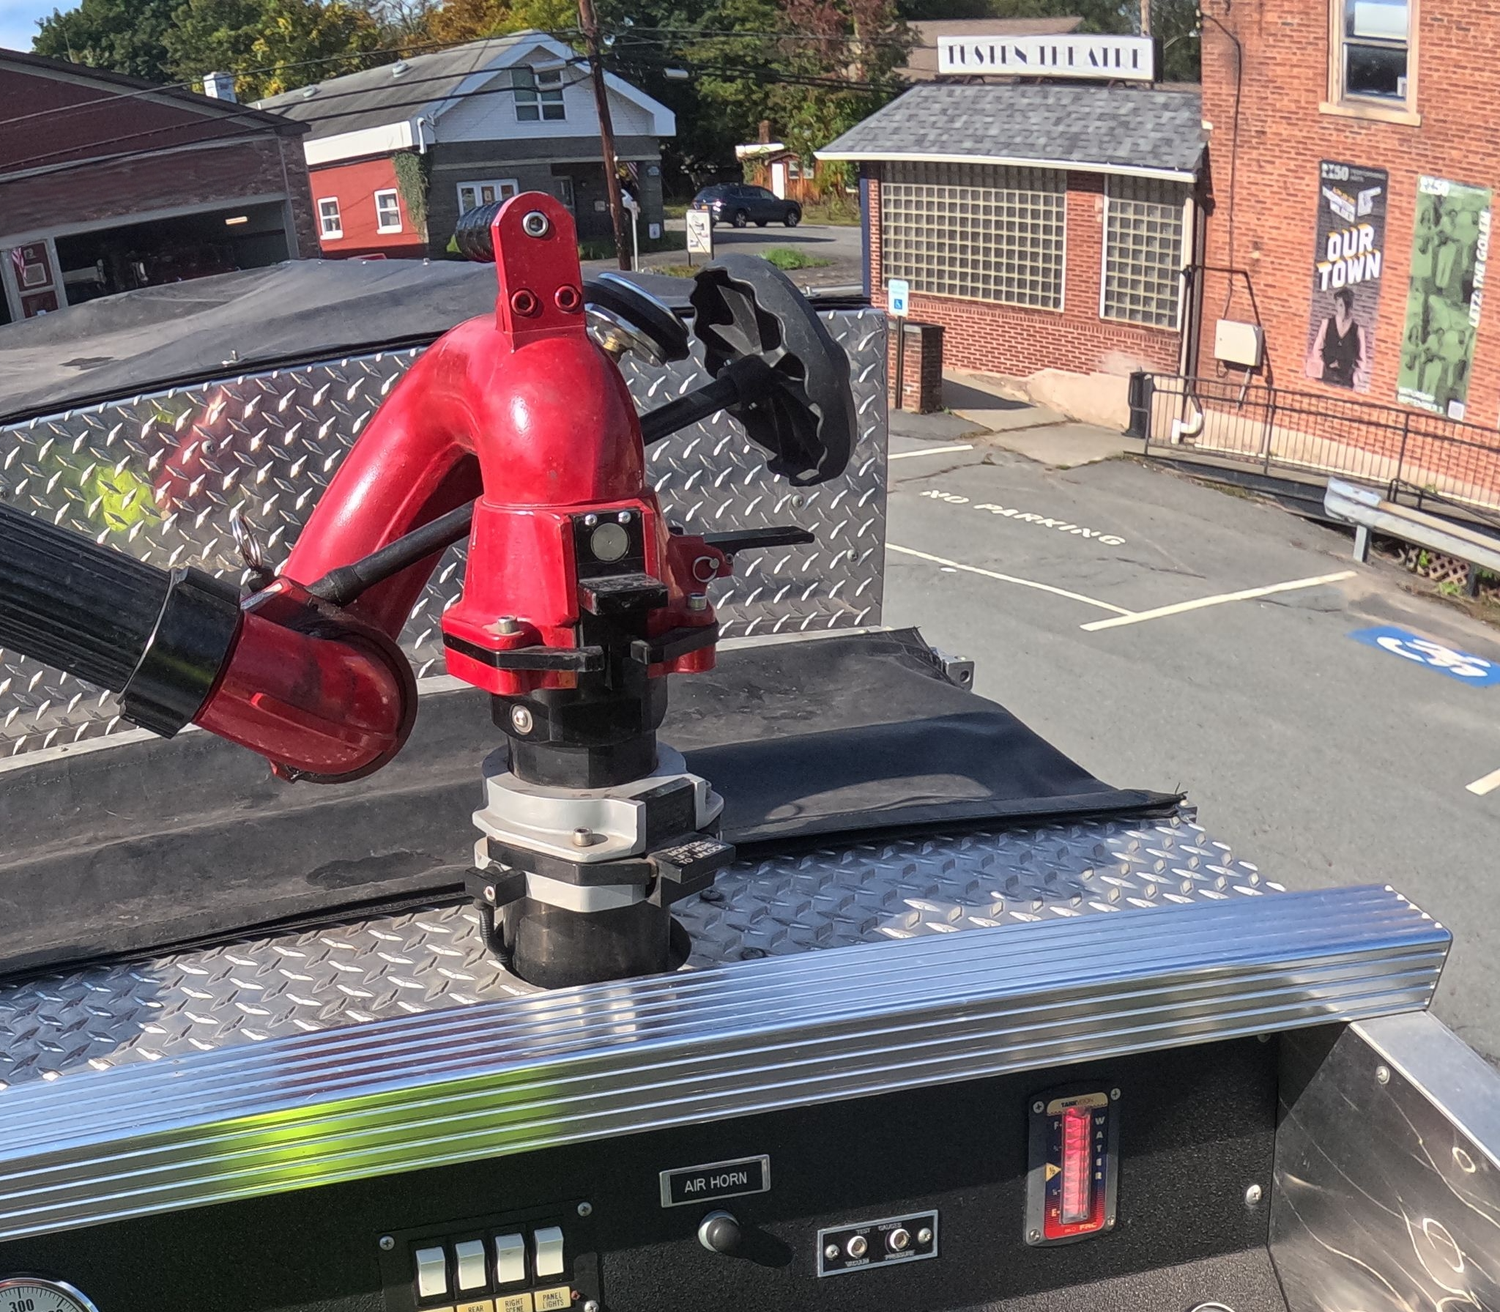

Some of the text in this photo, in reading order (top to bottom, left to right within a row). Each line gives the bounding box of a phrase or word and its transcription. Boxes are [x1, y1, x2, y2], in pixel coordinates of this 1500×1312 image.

[948, 44, 1144, 70] TUSTEN THEATRE
[1327, 223, 1374, 262] OUR
[1316, 250, 1381, 291] TOWN
[920, 490, 1126, 545] NO PARKING
[684, 1171, 747, 1193] AIR HORN
[505, 1298, 523, 1306] RIGHT
[542, 1292, 562, 1301] PANEL
[542, 1300, 564, 1309] LIGHTS
[468, 1305, 484, 1312] REAR
